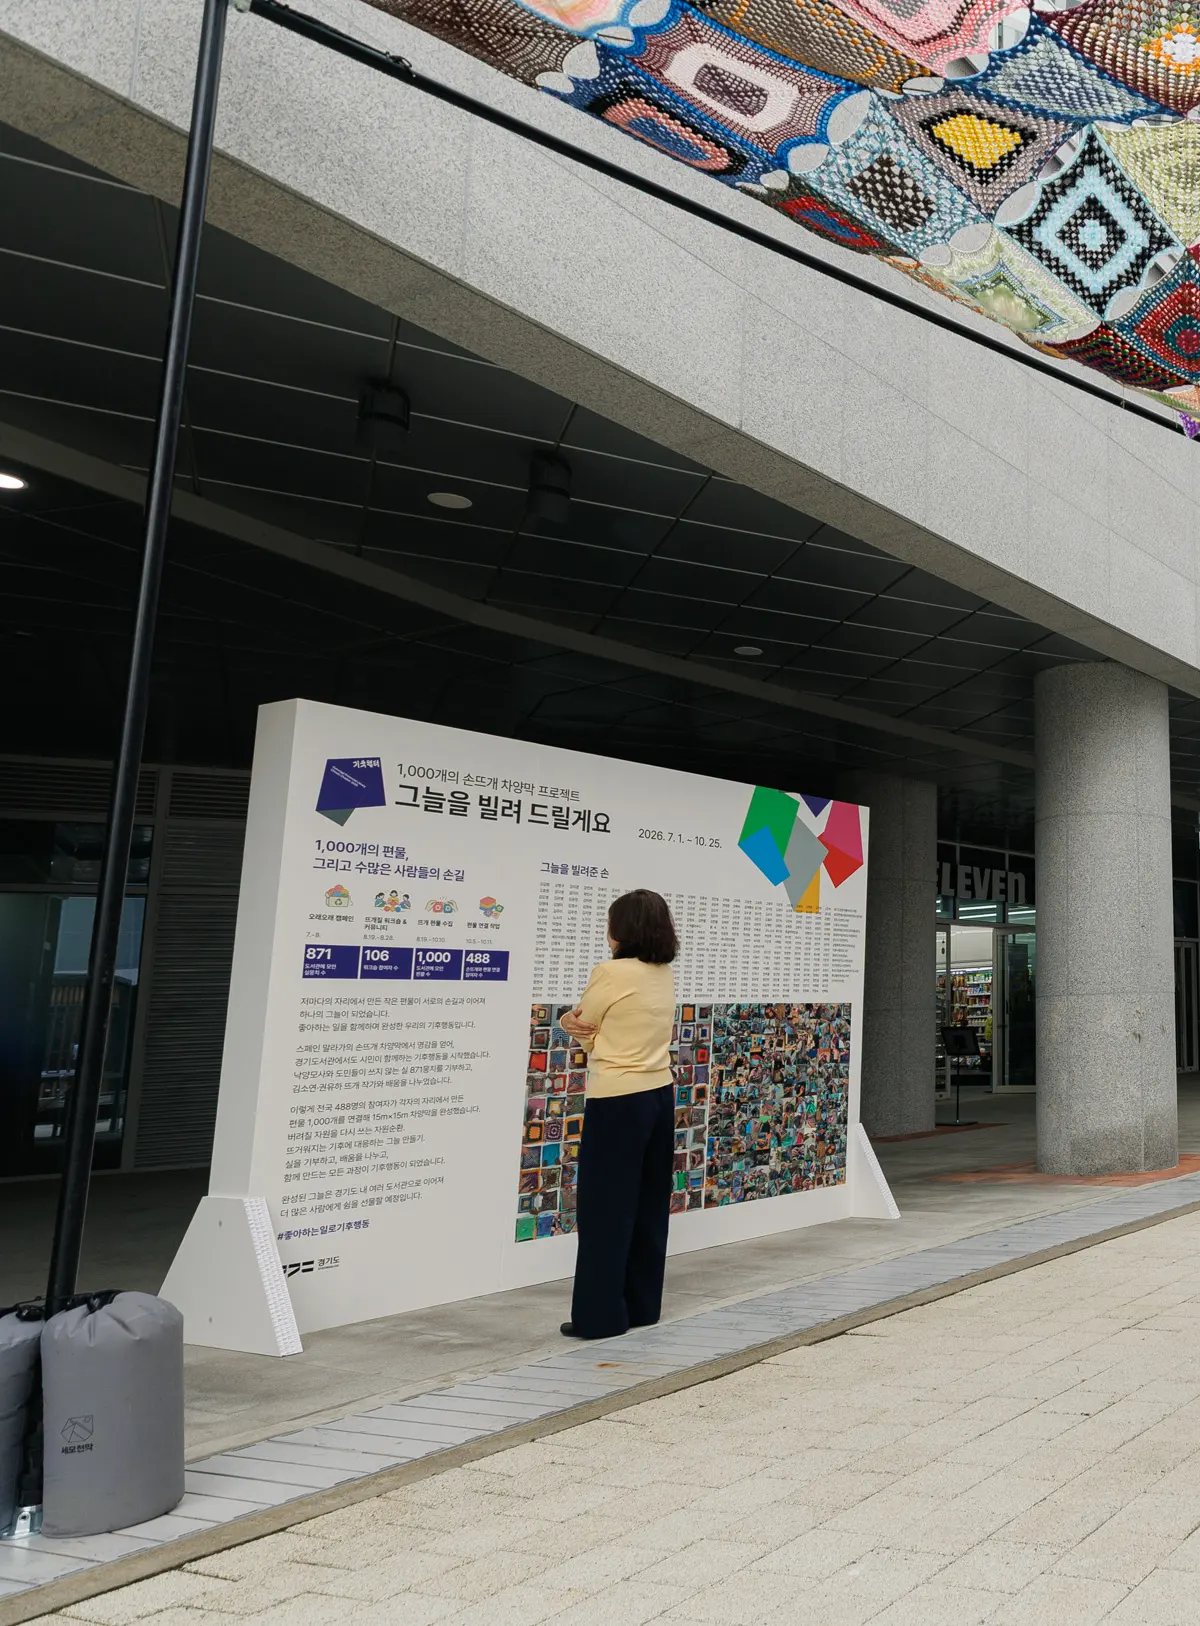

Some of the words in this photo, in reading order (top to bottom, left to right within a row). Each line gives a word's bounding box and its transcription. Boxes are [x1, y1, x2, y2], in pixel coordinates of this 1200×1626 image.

[397, 764, 458, 784] 1,000개의
[462, 772, 498, 790] 손뜨개
[501, 779, 535, 796] 차양막
[538, 785, 580, 802] 프로젝트
[395, 784, 470, 817] 그늘을
[478, 794, 521, 824] 빌려
[528, 804, 611, 833] 드릴게요
[638, 829, 665, 840] 2026.
[694, 835, 707, 846] 10.
[708, 837, 722, 848] 25.
[315, 840, 379, 857] 1,000개의
[382, 845, 409, 861] 편물,
[313, 858, 351, 872] 그리고
[355, 862, 391, 876] 수많은
[394, 865, 440, 880] 사람들의
[443, 870, 465, 882] 손길
[540, 862, 569, 875] 그늘을
[572, 865, 598, 878] 빌려준
[600, 867, 609, 878] 손
[937, 861, 1026, 904] LEVEn
[306, 948, 331, 960] 871
[364, 950, 389, 961] 106
[416, 952, 451, 964] 1,000
[466, 953, 490, 964] 488
[299, 1010, 323, 1019] 하나의
[326, 1010, 349, 1018] 그늘이
[298, 1023, 330, 1032] 좋아하는
[332, 1023, 347, 1031] 일을
[350, 1023, 379, 1031] 함께하며
[382, 1022, 403, 1030] 완성한
[427, 1021, 476, 1030] 기후행동입니다.
[296, 1044, 320, 1053] 스페인
[323, 1043, 353, 1052] 말라가의
[356, 1042, 377, 1051] 손뜨개
[380, 1042, 415, 1050] 차양막에서
[295, 1056, 357, 1066] 경기도서관에서도
[360, 1055, 382, 1064] 시민이
[384, 1054, 412, 1063] 함께하는
[414, 1052, 448, 1061] 기후행동을
[450, 1051, 490, 1060] 시작했습니다.
[336, 1068, 366, 1078] 도민들이
[368, 1068, 383, 1076] 쓰지
[385, 1067, 399, 1075] 않는
[401, 1067, 407, 1075] 실
[445, 1064, 472, 1073] 기부하고,
[344, 1081, 359, 1090] 뜨개
[362, 1080, 384, 1089] 작가와
[386, 1079, 407, 1088] 배움을
[409, 1077, 452, 1087] 나누었습니다.
[290, 1104, 315, 1114] 이렇게
[317, 1103, 332, 1112] 전국
[335, 1101, 365, 1111] 488명의
[368, 1099, 397, 1109] 참여자가
[399, 1098, 420, 1107] 각자의
[422, 1096, 449, 1105] 자리에서
[451, 1095, 464, 1104] 만든
[289, 1118, 306, 1128] 편물
[308, 1115, 345, 1127] 1,000개를
[348, 1114, 370, 1124] 연결해
[410, 1108, 437, 1119] 차양막을
[440, 1105, 480, 1116] 완성했습니다.
[287, 1131, 312, 1141] 버려질
[314, 1129, 338, 1139] 자원을
[340, 1128, 356, 1137] 다시
[358, 1126, 372, 1136] 쓰는
[374, 1124, 405, 1134] 자원순환.
[286, 1143, 326, 1154] 뜨거워지는
[329, 1140, 352, 1151] 기후에
[354, 1138, 384, 1148] 대응하는
[386, 1136, 400, 1146] 그늘
[402, 1134, 425, 1144] 만들기.
[285, 1159, 301, 1169] 실을
[304, 1156, 338, 1167] 기부하고,
[340, 1154, 363, 1164] 배움을
[365, 1152, 388, 1161] 나누고,
[284, 1172, 300, 1182] 함께
[302, 1169, 327, 1180] 만드는
[329, 1168, 344, 1177] 모든
[346, 1165, 369, 1175] 과정이
[371, 1161, 407, 1173] 기후행동이
[410, 1157, 445, 1168] 되었습니다.
[282, 1193, 307, 1204] 완성된
[309, 1190, 332, 1201] 그늘은
[335, 1187, 358, 1198] 경기도
[360, 1186, 368, 1195] 내
[370, 1184, 384, 1193] 여러
[386, 1179, 421, 1191] 도서관으로
[423, 1176, 444, 1186] 이어져
[280, 1208, 288, 1218] 더
[291, 1206, 307, 1217] 많은
[309, 1202, 341, 1214] 사람에게
[361, 1197, 383, 1208] 선물할
[385, 1192, 422, 1205] 예정입니다.
[277, 1219, 370, 1241] #좋아하는일로기후행동
[318, 1256, 340, 1266] 경기도
